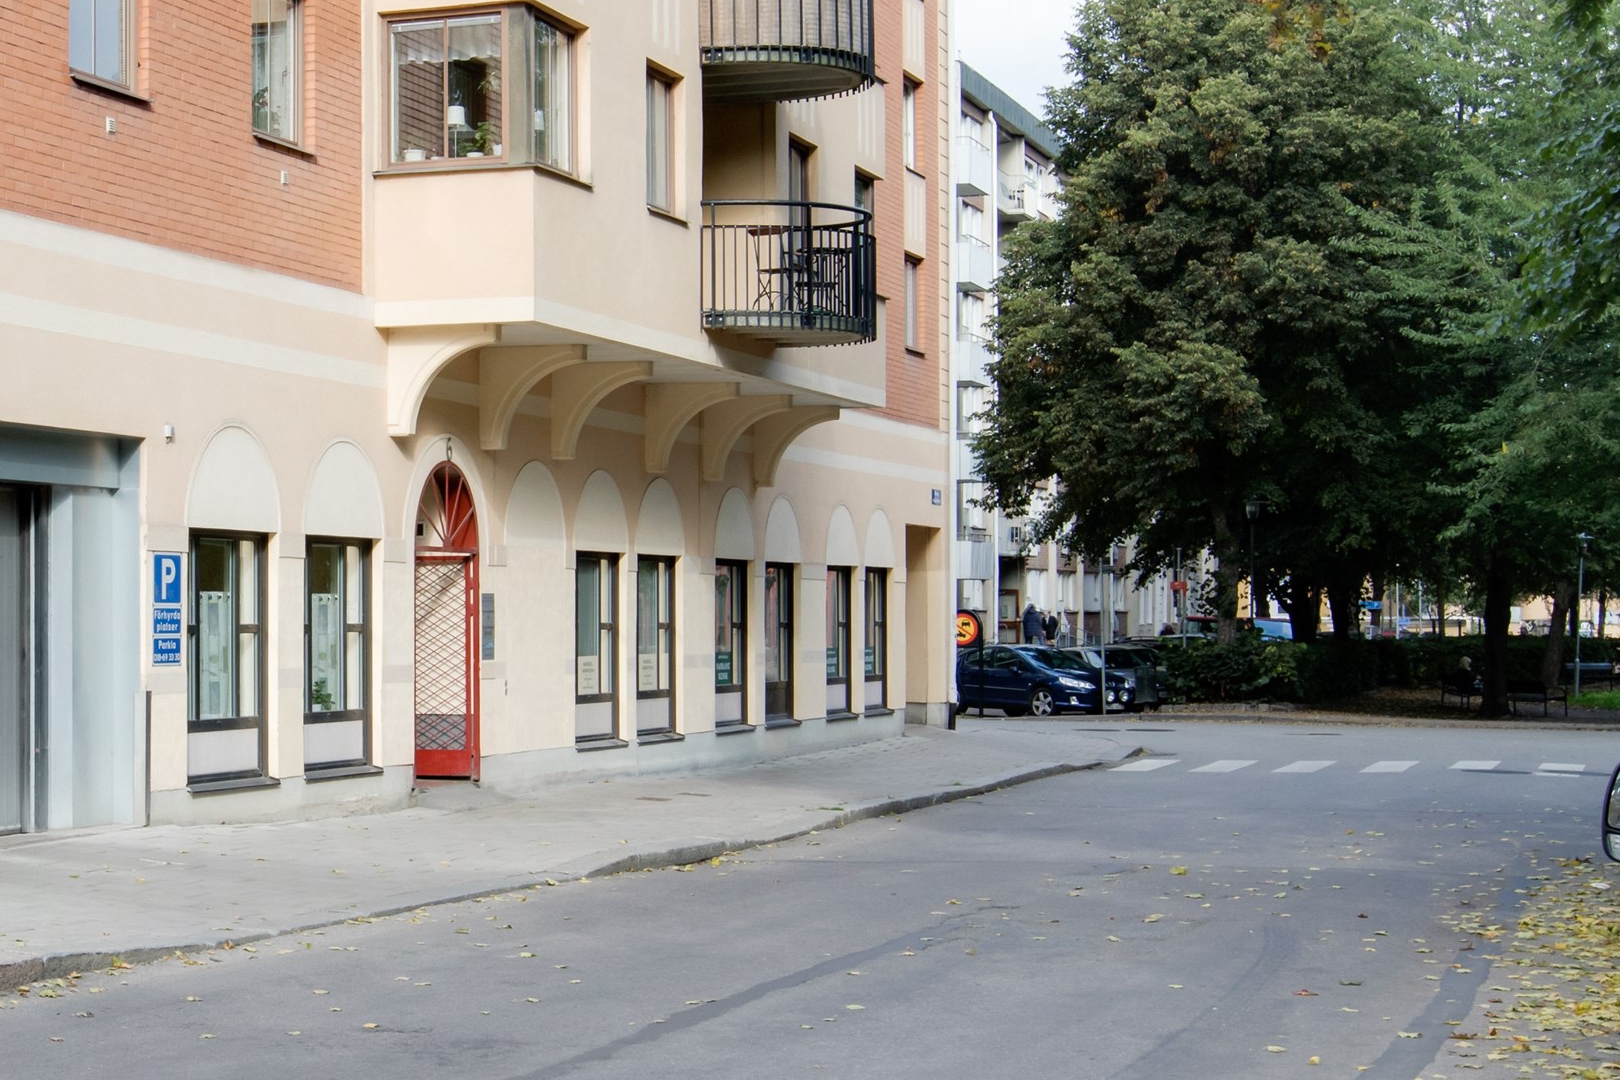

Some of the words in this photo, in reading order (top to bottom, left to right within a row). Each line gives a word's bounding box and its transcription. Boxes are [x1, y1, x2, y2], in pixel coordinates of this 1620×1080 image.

[446, 437, 453, 461] 6
[161, 558, 176, 600] P
[154, 610, 181, 622] Förhyrda
[156, 621, 178, 633] platser
